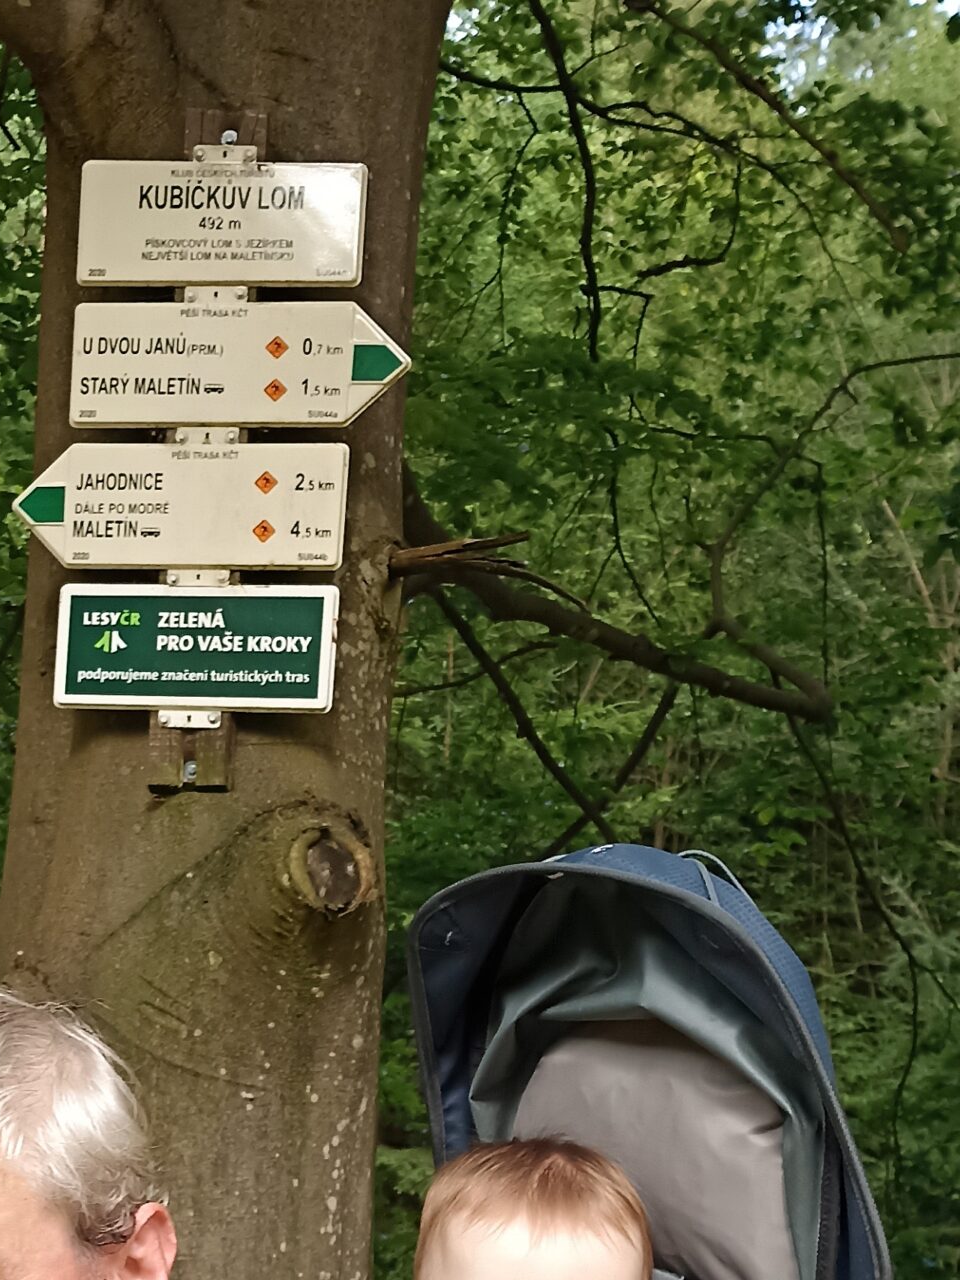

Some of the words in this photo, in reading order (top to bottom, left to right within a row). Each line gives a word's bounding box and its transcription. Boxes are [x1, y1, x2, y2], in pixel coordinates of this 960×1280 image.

[139, 179, 251, 210] KUBÍČKŮV
[258, 186, 305, 210] LOM
[199, 216, 224, 231] 492
[228, 219, 241, 230] m
[211, 239, 233, 248] LOM
[190, 252, 212, 261] LOM
[215, 252, 228, 261] NA
[83, 337, 93, 354] U
[97, 337, 141, 354] DVOU
[326, 345, 343, 355] km
[80, 373, 129, 395] STARÝ
[133, 373, 201, 395] MALETÍN
[324, 386, 341, 396] km
[76, 472, 163, 491] JAHODNICE
[318, 480, 335, 490] km
[74, 501, 104, 514] DÁLE
[108, 503, 125, 514] PO
[72, 516, 138, 537] MALETÍN
[315, 528, 331, 537] km
[158, 608, 225, 628] ZELENÁ
[156, 635, 194, 651] PRO
[197, 631, 244, 652] VAŠE
[247, 636, 312, 652] KROKY
[77, 668, 159, 684] podporujeme
[161, 669, 208, 681] značení
[210, 670, 283, 685] turistických
[285, 671, 310, 683] tras
